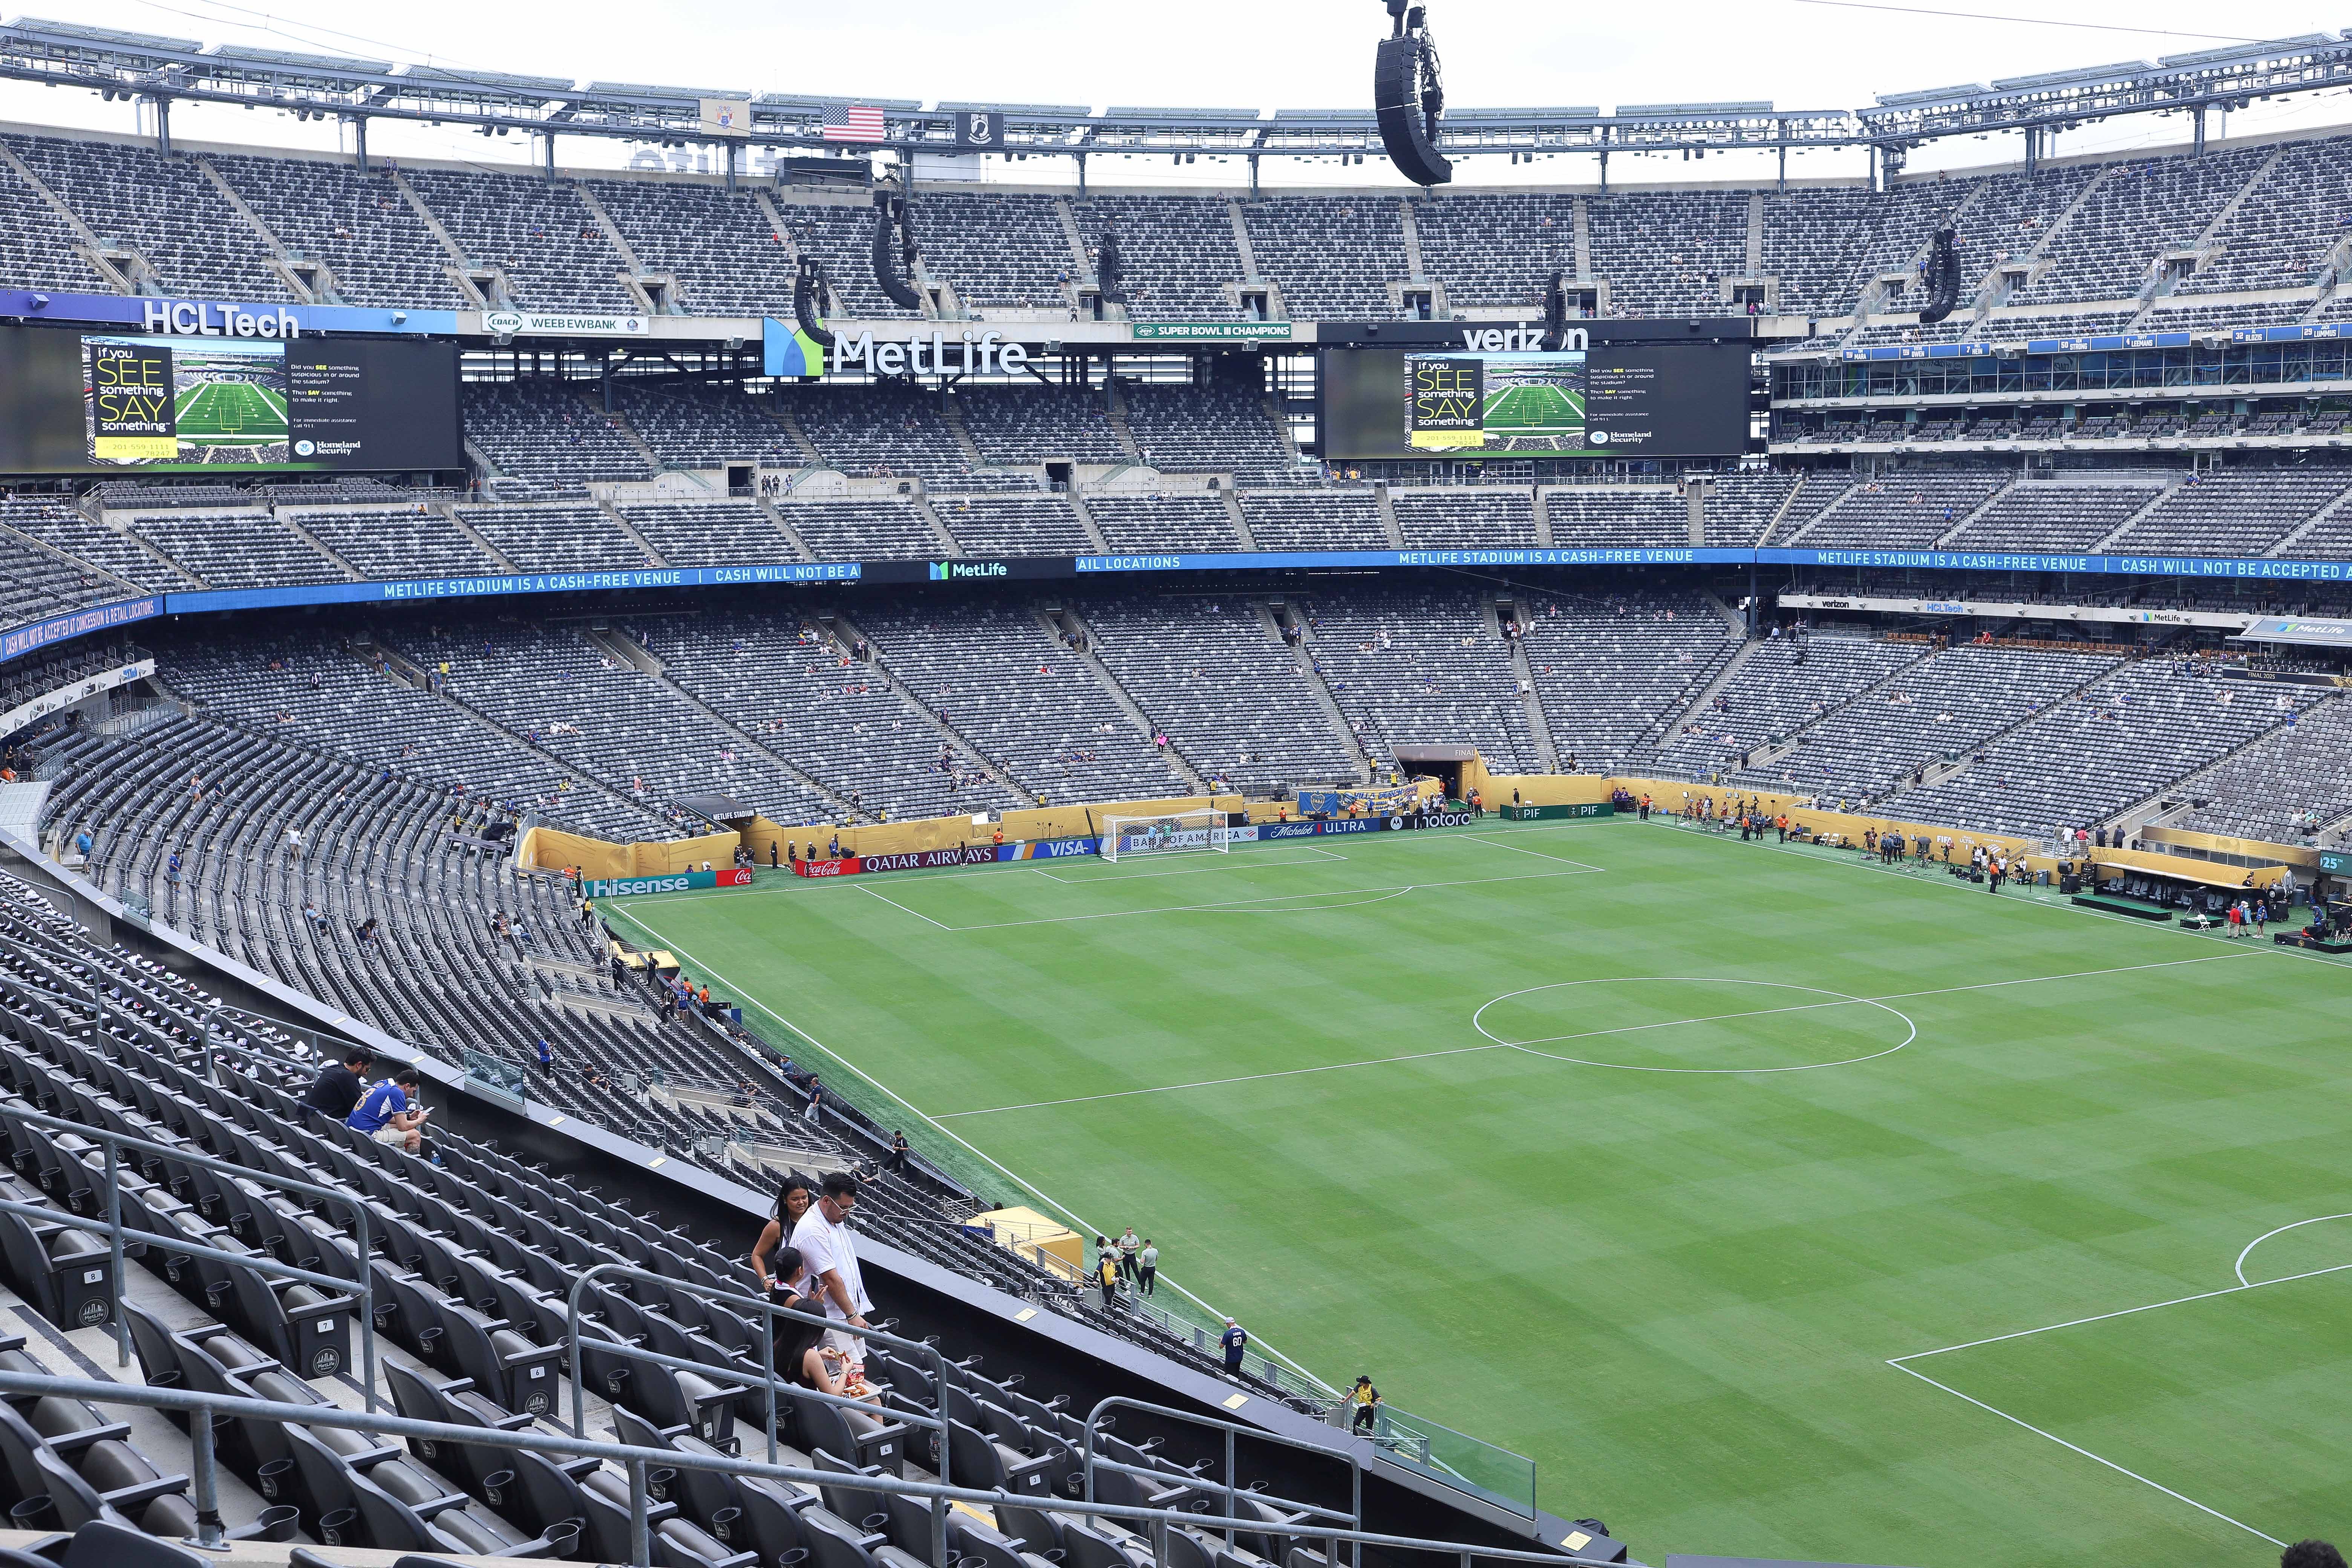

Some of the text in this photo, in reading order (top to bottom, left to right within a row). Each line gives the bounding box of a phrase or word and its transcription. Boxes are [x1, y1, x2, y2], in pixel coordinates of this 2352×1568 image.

[144, 301, 299, 338] HCLTech
[531, 318, 617, 329] WEEB EWBANK
[1158, 326, 1289, 335] SUPER BOWL III CHAMPIONS
[1462, 322, 1588, 351] verizn
[2131, 339, 2153, 347] LEEMANS
[98, 348, 133, 359] if you
[833, 330, 1027, 375] MetLife
[97, 358, 164, 386] SEE
[1417, 370, 1474, 390] SEE
[100, 386, 164, 397] something
[1418, 390, 1475, 399] something
[99, 395, 167, 422] SAY
[1417, 398, 1477, 419] SAY
[1106, 556, 1180, 569] LOCATIONS
[1399, 550, 1694, 564] METLIFE STADIUM IS A CASH-FREE VENUE
[1818, 552, 2086, 570] METLIFE STADIUM IS A CASH-FREE VENUE
[715, 565, 845, 582] CASH WILL NOT BE
[952, 562, 1007, 577] MetLife
[2121, 559, 2340, 578] CASH WILL NOT BE ACCEPTED
[384, 571, 681, 597] METLIFE STADIUM IS A CASH-FREE VENUE
[1822, 600, 1849, 608] verizon
[1927, 603, 1963, 613] HCLTech
[2154, 614, 2180, 622] MetLife
[6, 634, 17, 655] CASH
[17, 632, 29, 652] WILL
[37, 629, 43, 643] BE
[44, 620, 69, 640] ACCEPTED
[70, 618, 75, 634] AT
[76, 612, 104, 632] CONCESSION
[106, 609, 109, 624] &
[110, 606, 128, 623] RETAIL
[129, 600, 154, 617] LOCATIONS
[2295, 625, 2345, 634] MetLife
[713, 809, 754, 821] METLIFE STADIUM
[1524, 808, 1540, 818] PIF
[1581, 805, 1598, 815] PIF
[1271, 821, 1366, 838] Michelob ULTRA
[1937, 835, 1952, 844] FIFA
[1046, 840, 1084, 856] VISA
[867, 848, 992, 871] QATAR AIRWAYS
[593, 877, 689, 897] Hisense
[1233, 1337, 1242, 1346] 60
